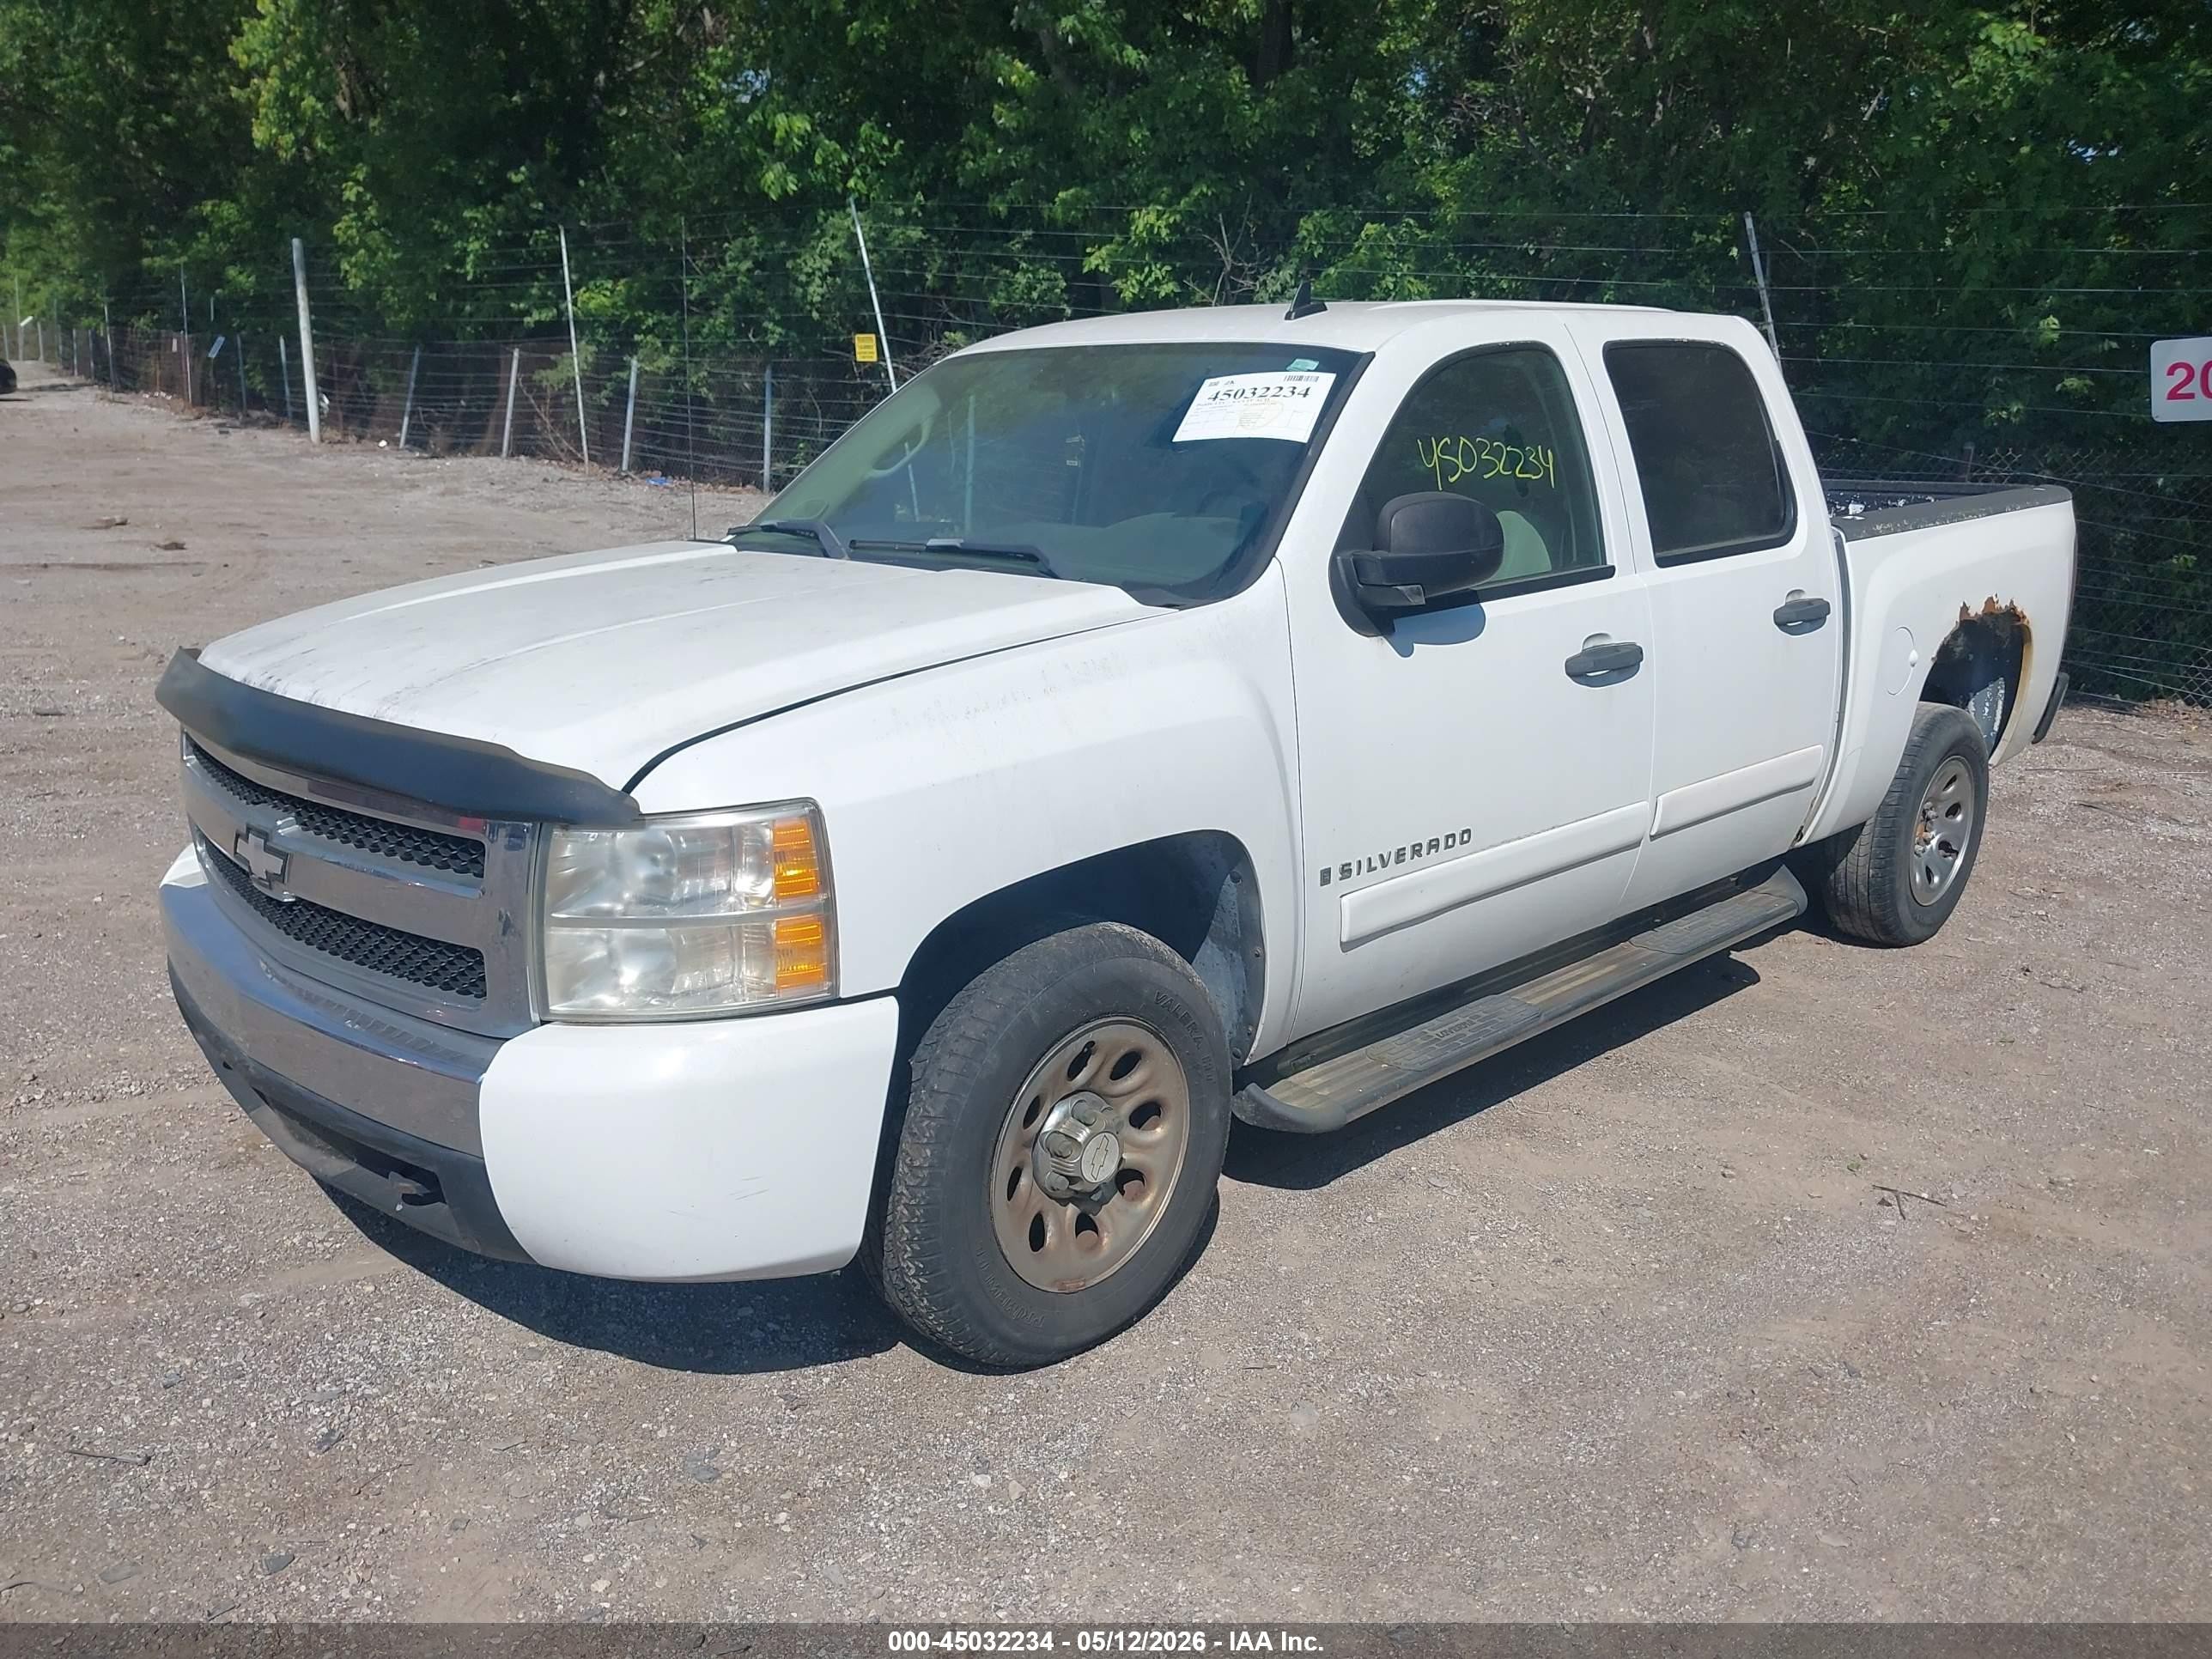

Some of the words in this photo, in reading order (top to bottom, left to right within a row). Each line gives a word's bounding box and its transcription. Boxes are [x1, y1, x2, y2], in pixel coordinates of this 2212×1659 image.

[1208, 386, 1310, 401] 45032234
[1417, 436, 1555, 491] 45032234
[1338, 828, 1472, 881] SILVERADO
